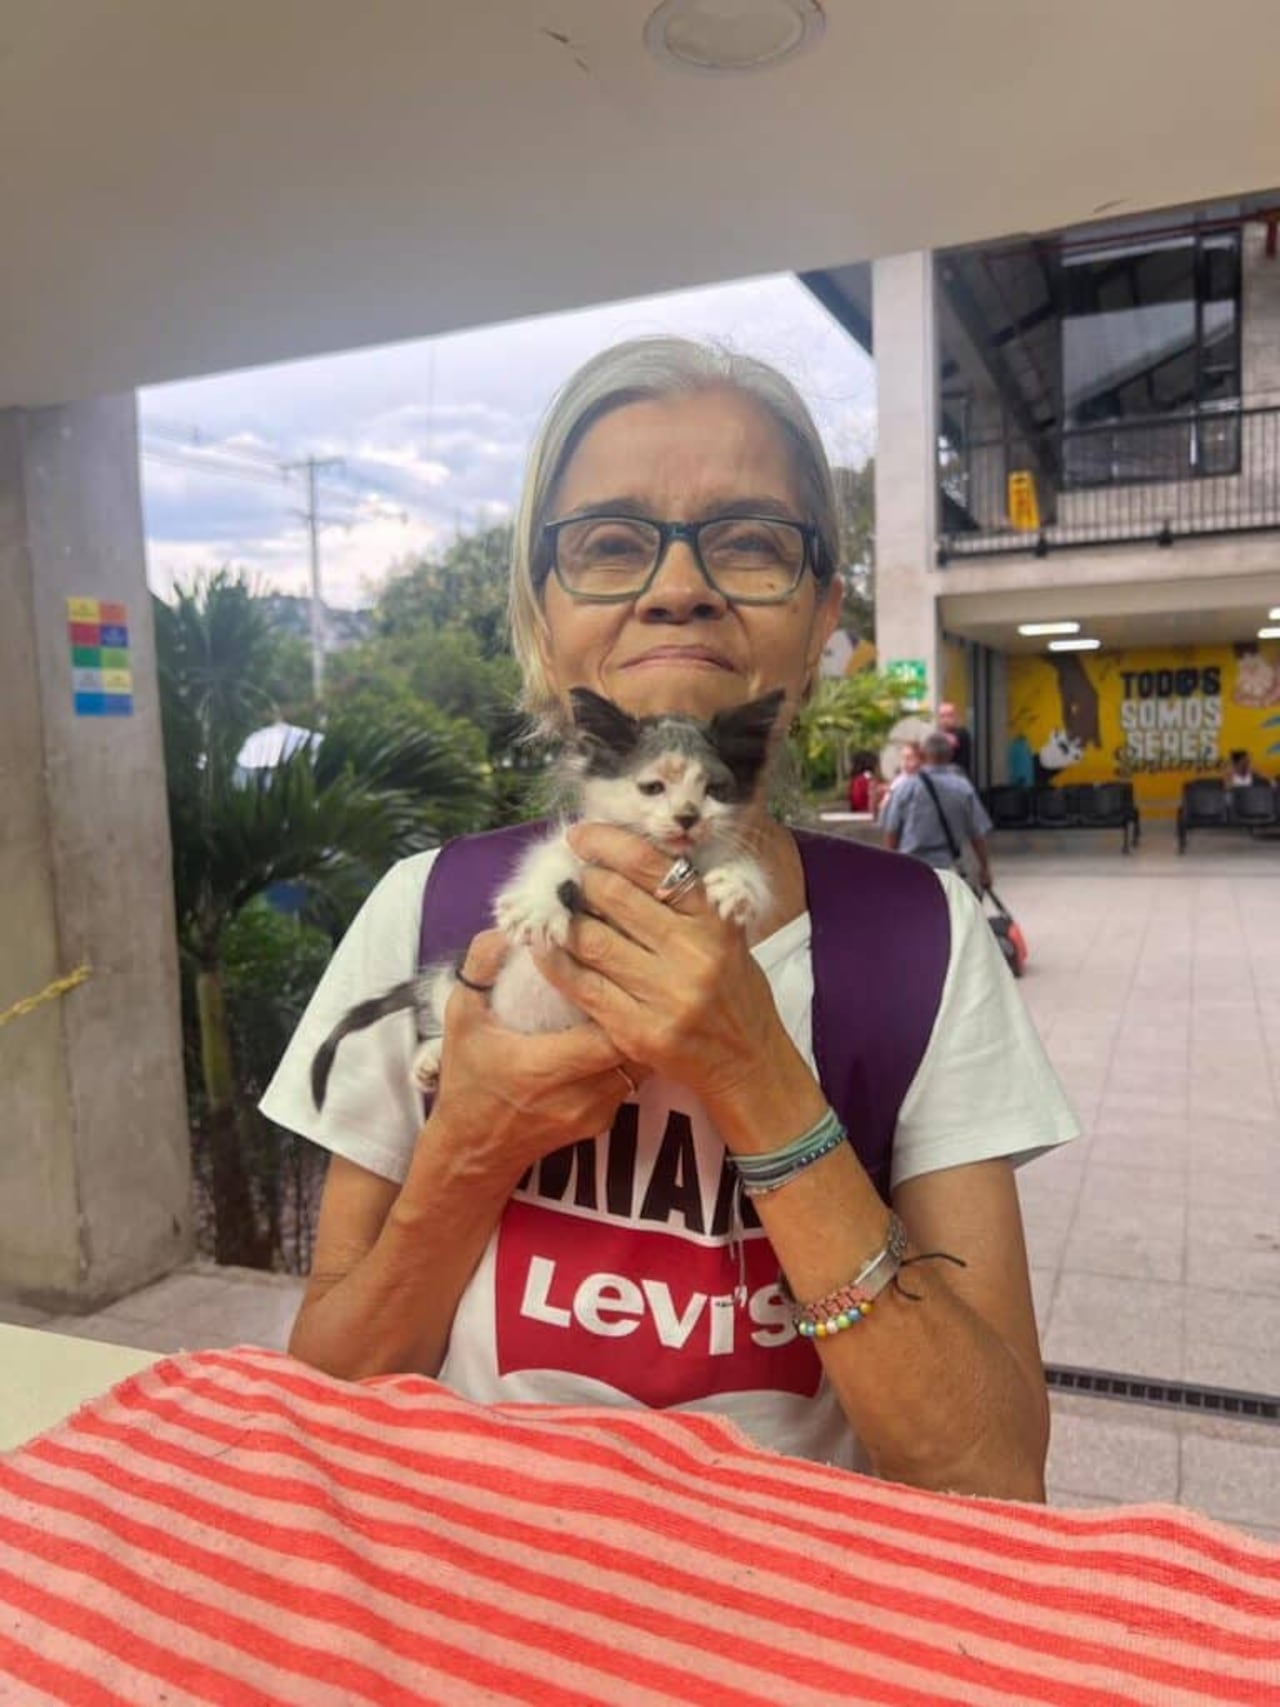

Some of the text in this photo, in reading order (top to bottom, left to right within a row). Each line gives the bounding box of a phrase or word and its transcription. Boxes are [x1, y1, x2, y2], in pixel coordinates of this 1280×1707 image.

[1121, 696, 1221, 729] SOMOS
[1127, 730, 1218, 761] SERES
[520, 1256, 798, 1356] Levi's
